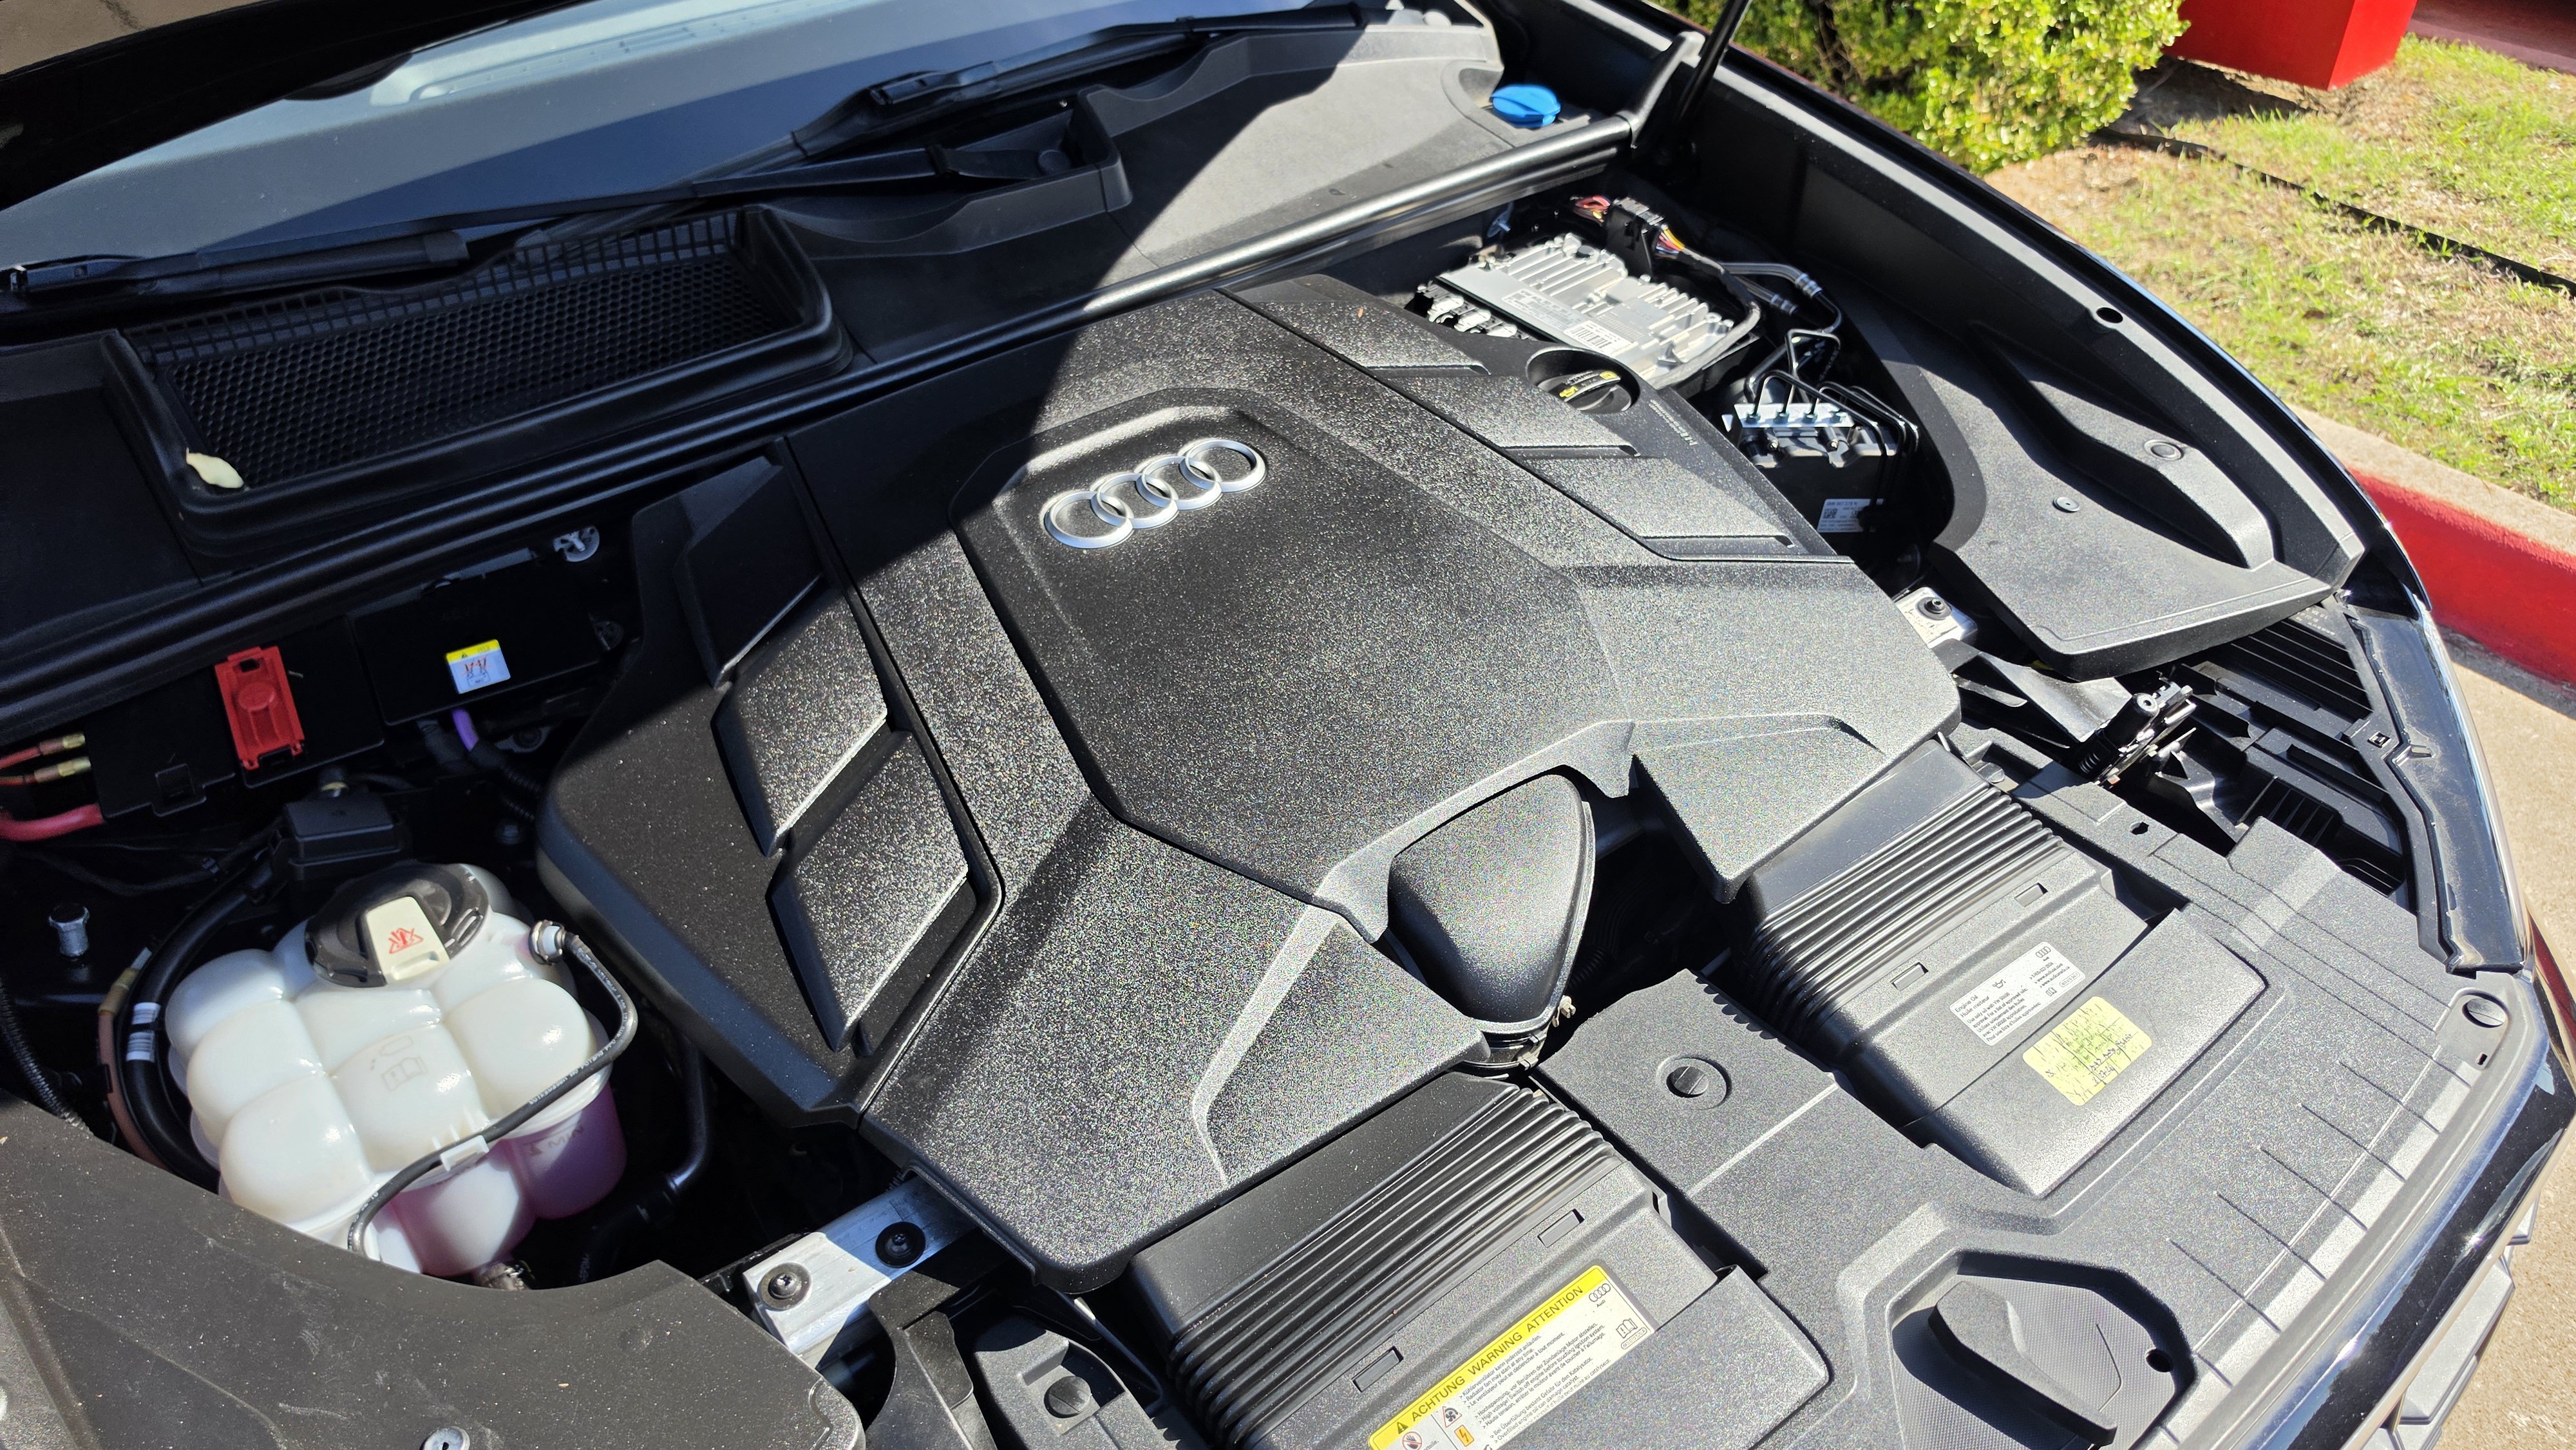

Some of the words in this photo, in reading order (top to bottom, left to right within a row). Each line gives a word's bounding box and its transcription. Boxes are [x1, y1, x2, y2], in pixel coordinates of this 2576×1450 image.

[1954, 999, 1972, 1013] Engine
[1960, 1006, 1973, 1017] Huile
[1972, 995, 1990, 1009] moteur
[1596, 1299, 1605, 1308] Audi
[1409, 1374, 1466, 1422] ACHTUNG
[1467, 1330, 1522, 1377] WARNING
[1524, 1284, 1583, 1333] ATTENTION
[1465, 1385, 1484, 1402] Radiator
[1483, 1379, 1492, 1388] fan
[1491, 1372, 1502, 1382] may
[1500, 1364, 1511, 1374] start
[1515, 1355, 1524, 1364] any
[1475, 1382, 1498, 1402] ventilateur
[1497, 1375, 1508, 1385] peut
[1511, 1353, 1535, 1373] déclencher
[1537, 1344, 1547, 1353] tout
[1546, 1330, 1565, 1347] moment.
[1481, 1411, 1493, 1422] High
[1508, 1386, 1524, 1400] Switch
[1530, 1370, 1546, 1384] engine
[1543, 1359, 1558, 1373] before
[1557, 1346, 1575, 1363] touching
[1573, 1335, 1590, 1350] ignition
[1589, 1323, 1605, 1338] system.
[1494, 1360, 1506, 1371] kann
[1504, 1347, 1523, 1364] jederzeit
[1516, 1368, 1537, 1386] Berühren
[1535, 1362, 1544, 1371] der
[1542, 1344, 1567, 1366] Zündanlage
[1565, 1335, 1579, 1347] Motor
[1485, 1413, 1499, 1426] Haute
[1514, 1389, 1530, 1404] arrêter
[1533, 1375, 1549, 1389] moteur
[1548, 1366, 1560, 1377] avant
[1564, 1349, 1582, 1364] toucher
[1493, 1427, 1501, 1435] Bei
[1524, 1395, 1541, 1410] besteht
[1540, 1384, 1555, 1398] Gefahr
[1560, 1373, 1570, 1382] den
[1497, 1422, 1519, 1440] Overfilled
[1517, 1410, 1533, 1425] engine
[1537, 1400, 1547, 1409] can
[1545, 1387, 1563, 1403] damage
